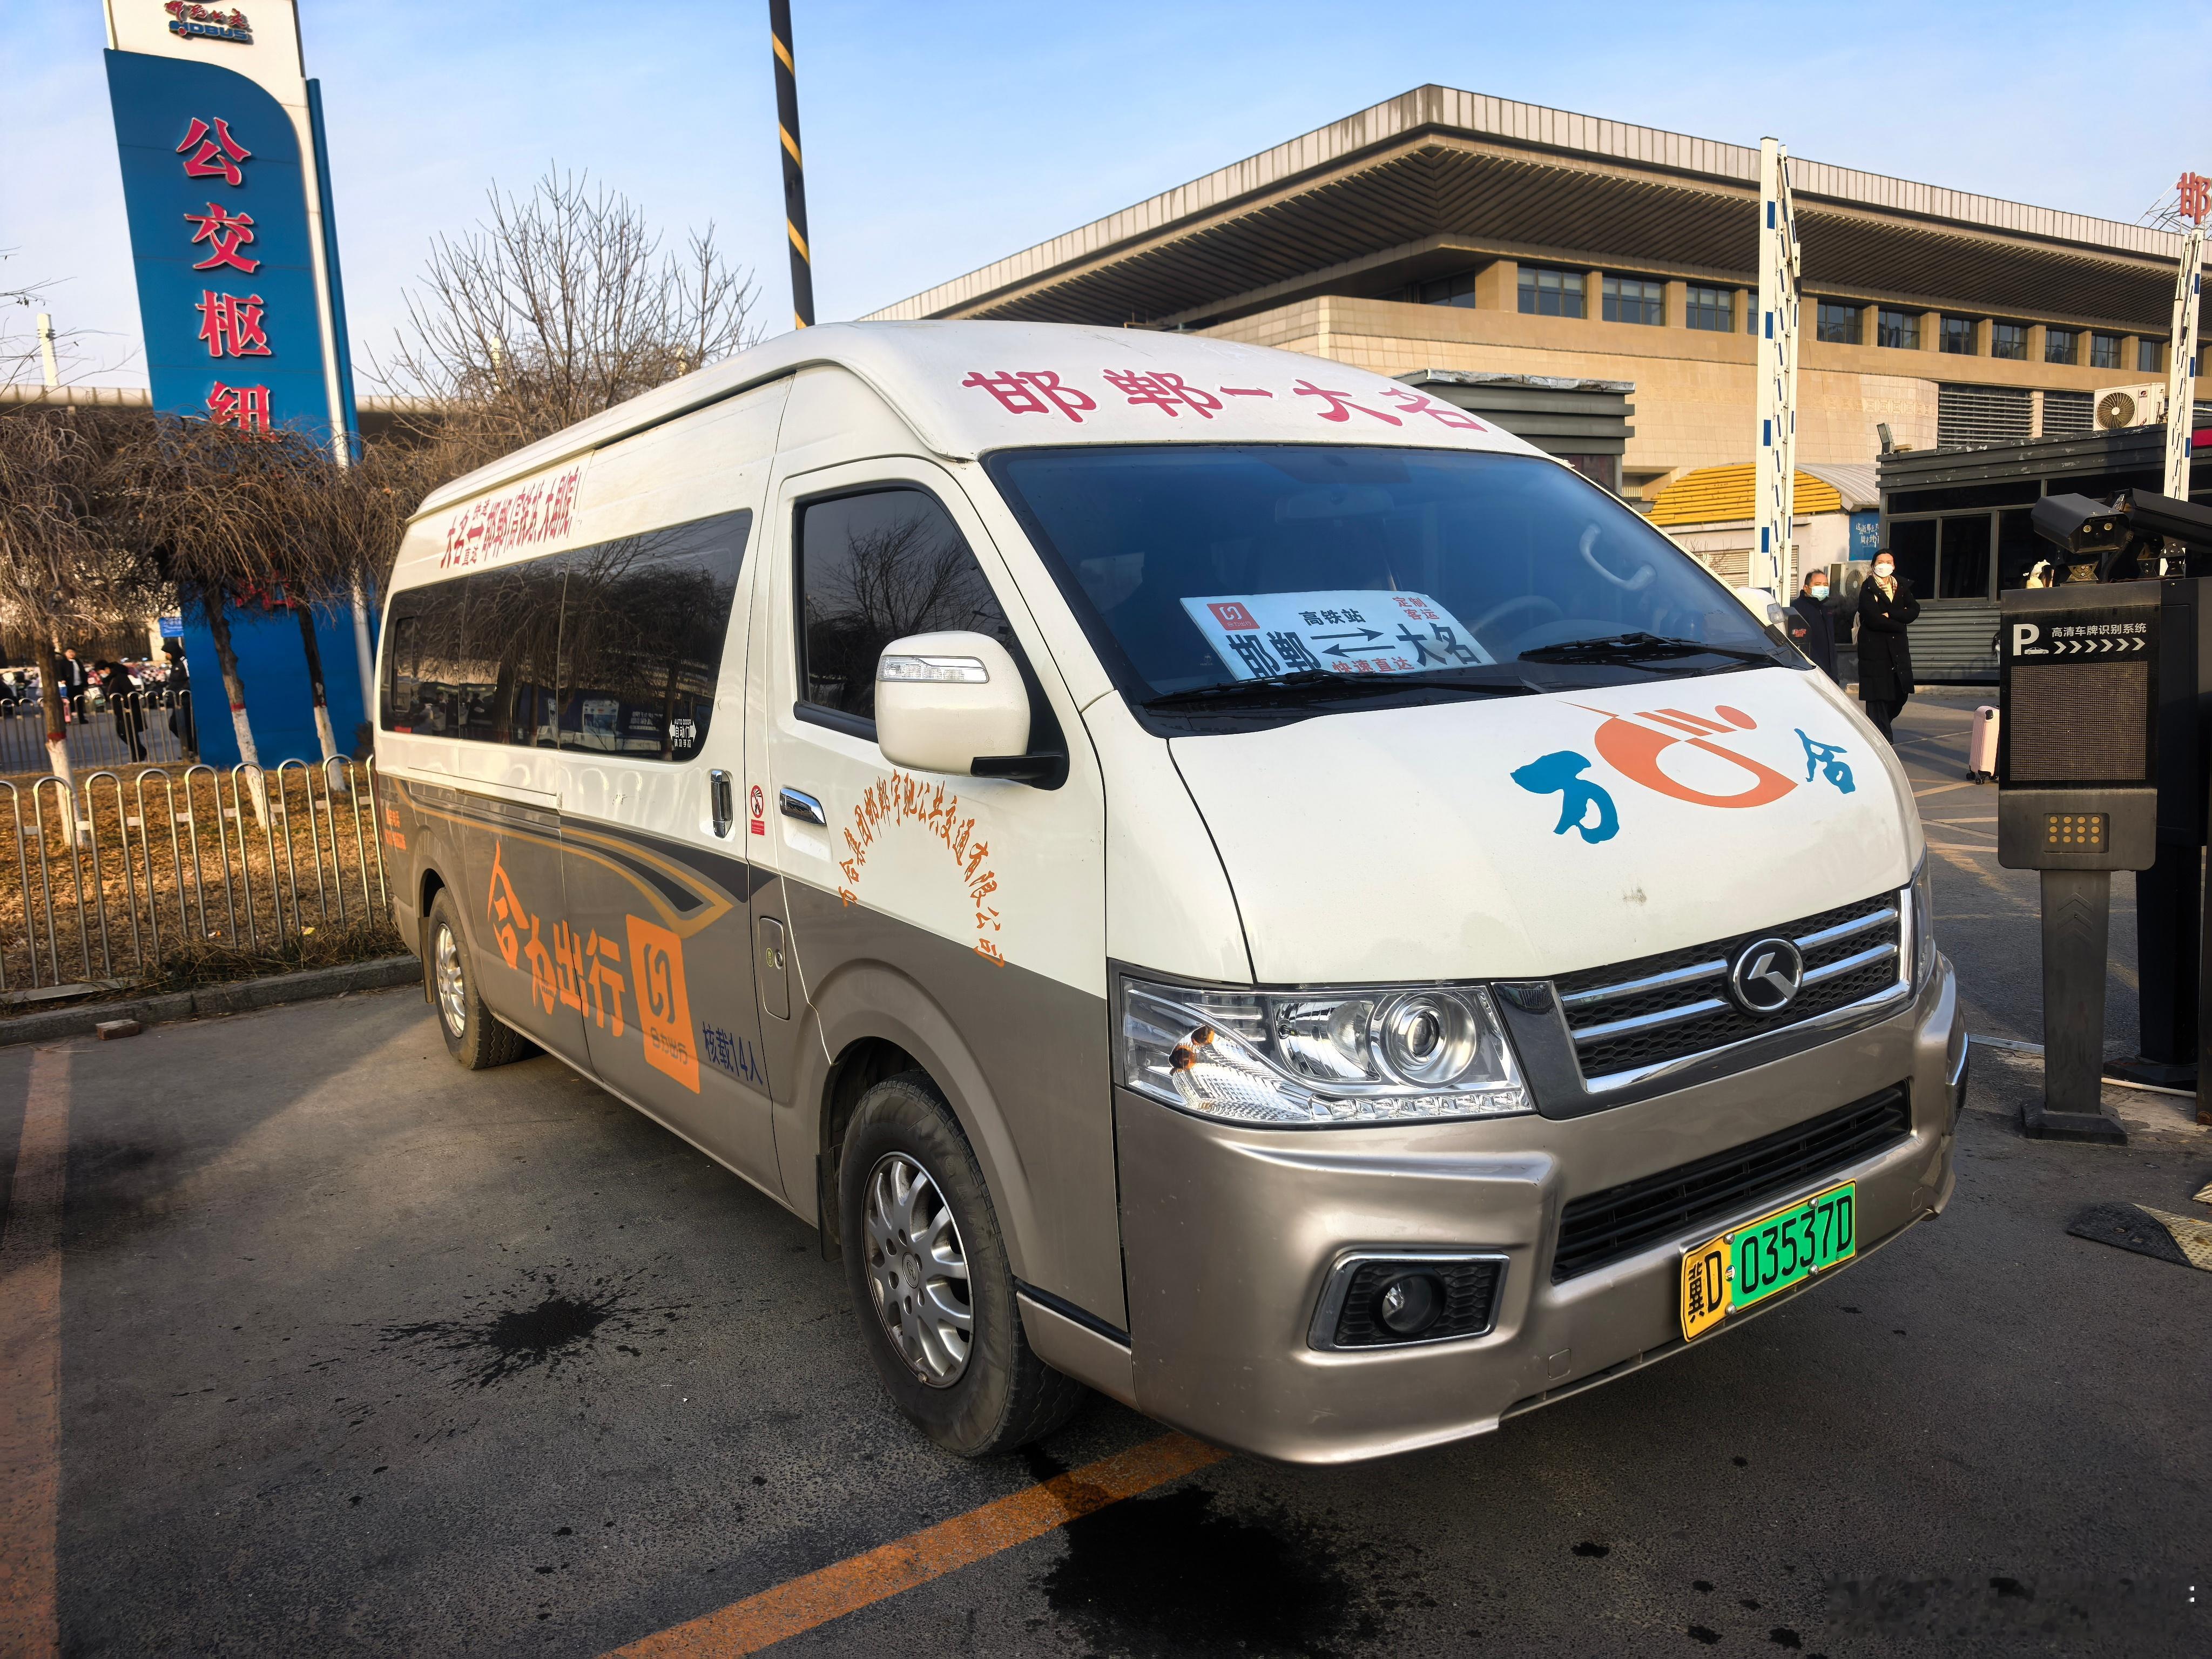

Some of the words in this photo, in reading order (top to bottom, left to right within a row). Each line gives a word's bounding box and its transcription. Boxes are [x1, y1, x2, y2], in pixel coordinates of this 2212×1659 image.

[2176, 171, 2211, 225] 邯
[1392, 596, 1428, 609] 定制
[1298, 608, 1366, 626] 高铁站
[1402, 608, 1440, 621] 客运
[2051, 623, 2147, 638] 高清车牌识别系统
[2013, 624, 2040, 656] P
[1225, 631, 1322, 678] 邯郸
[1395, 622, 1482, 667] 大名
[1331, 656, 1415, 673] 快速直达
[675, 725, 690, 738] 自动门
[702, 1021, 763, 1085] 核载14人
